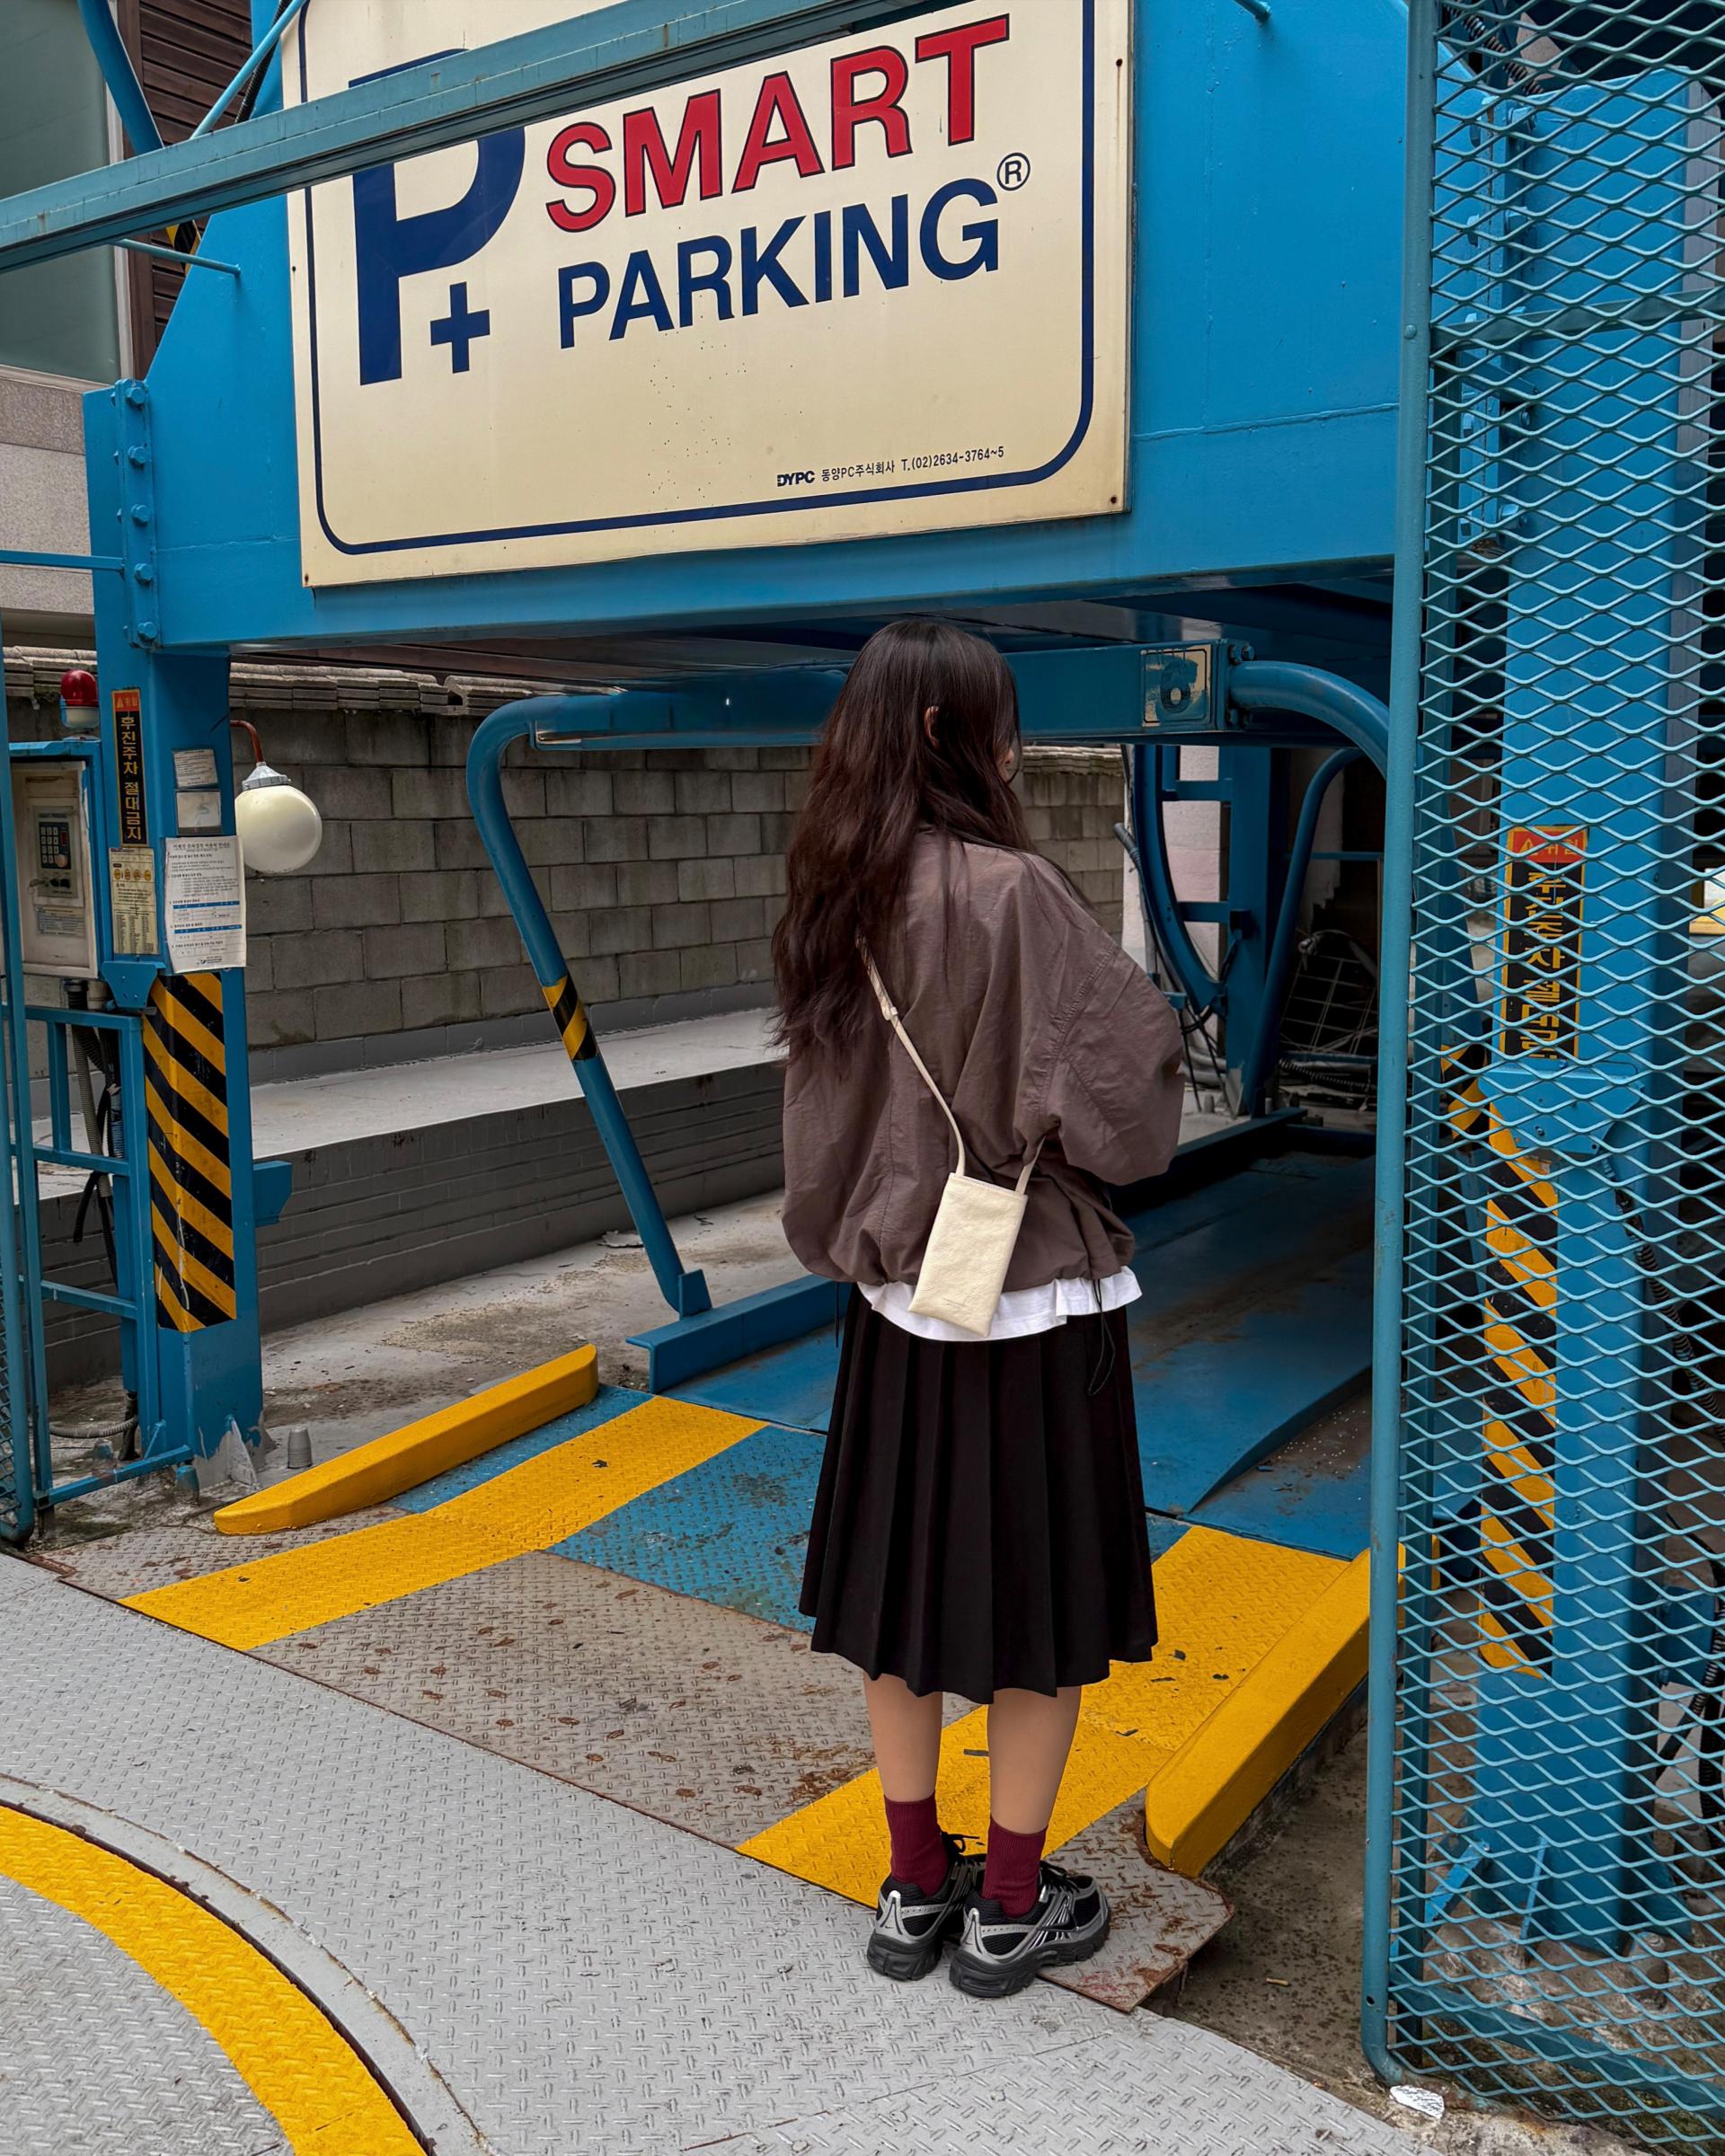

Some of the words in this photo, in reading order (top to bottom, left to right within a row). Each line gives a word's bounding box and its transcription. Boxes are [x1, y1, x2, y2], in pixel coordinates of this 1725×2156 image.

[545, 13, 1010, 234] SMART
[776, 470, 816, 487] DYPC
[821, 459, 895, 482] 동양PC주식회사
[901, 446, 1004, 472] T.(02)2634-3764~5
[120, 717, 138, 775] 후진주차
[124, 782, 141, 840] 절대금지
